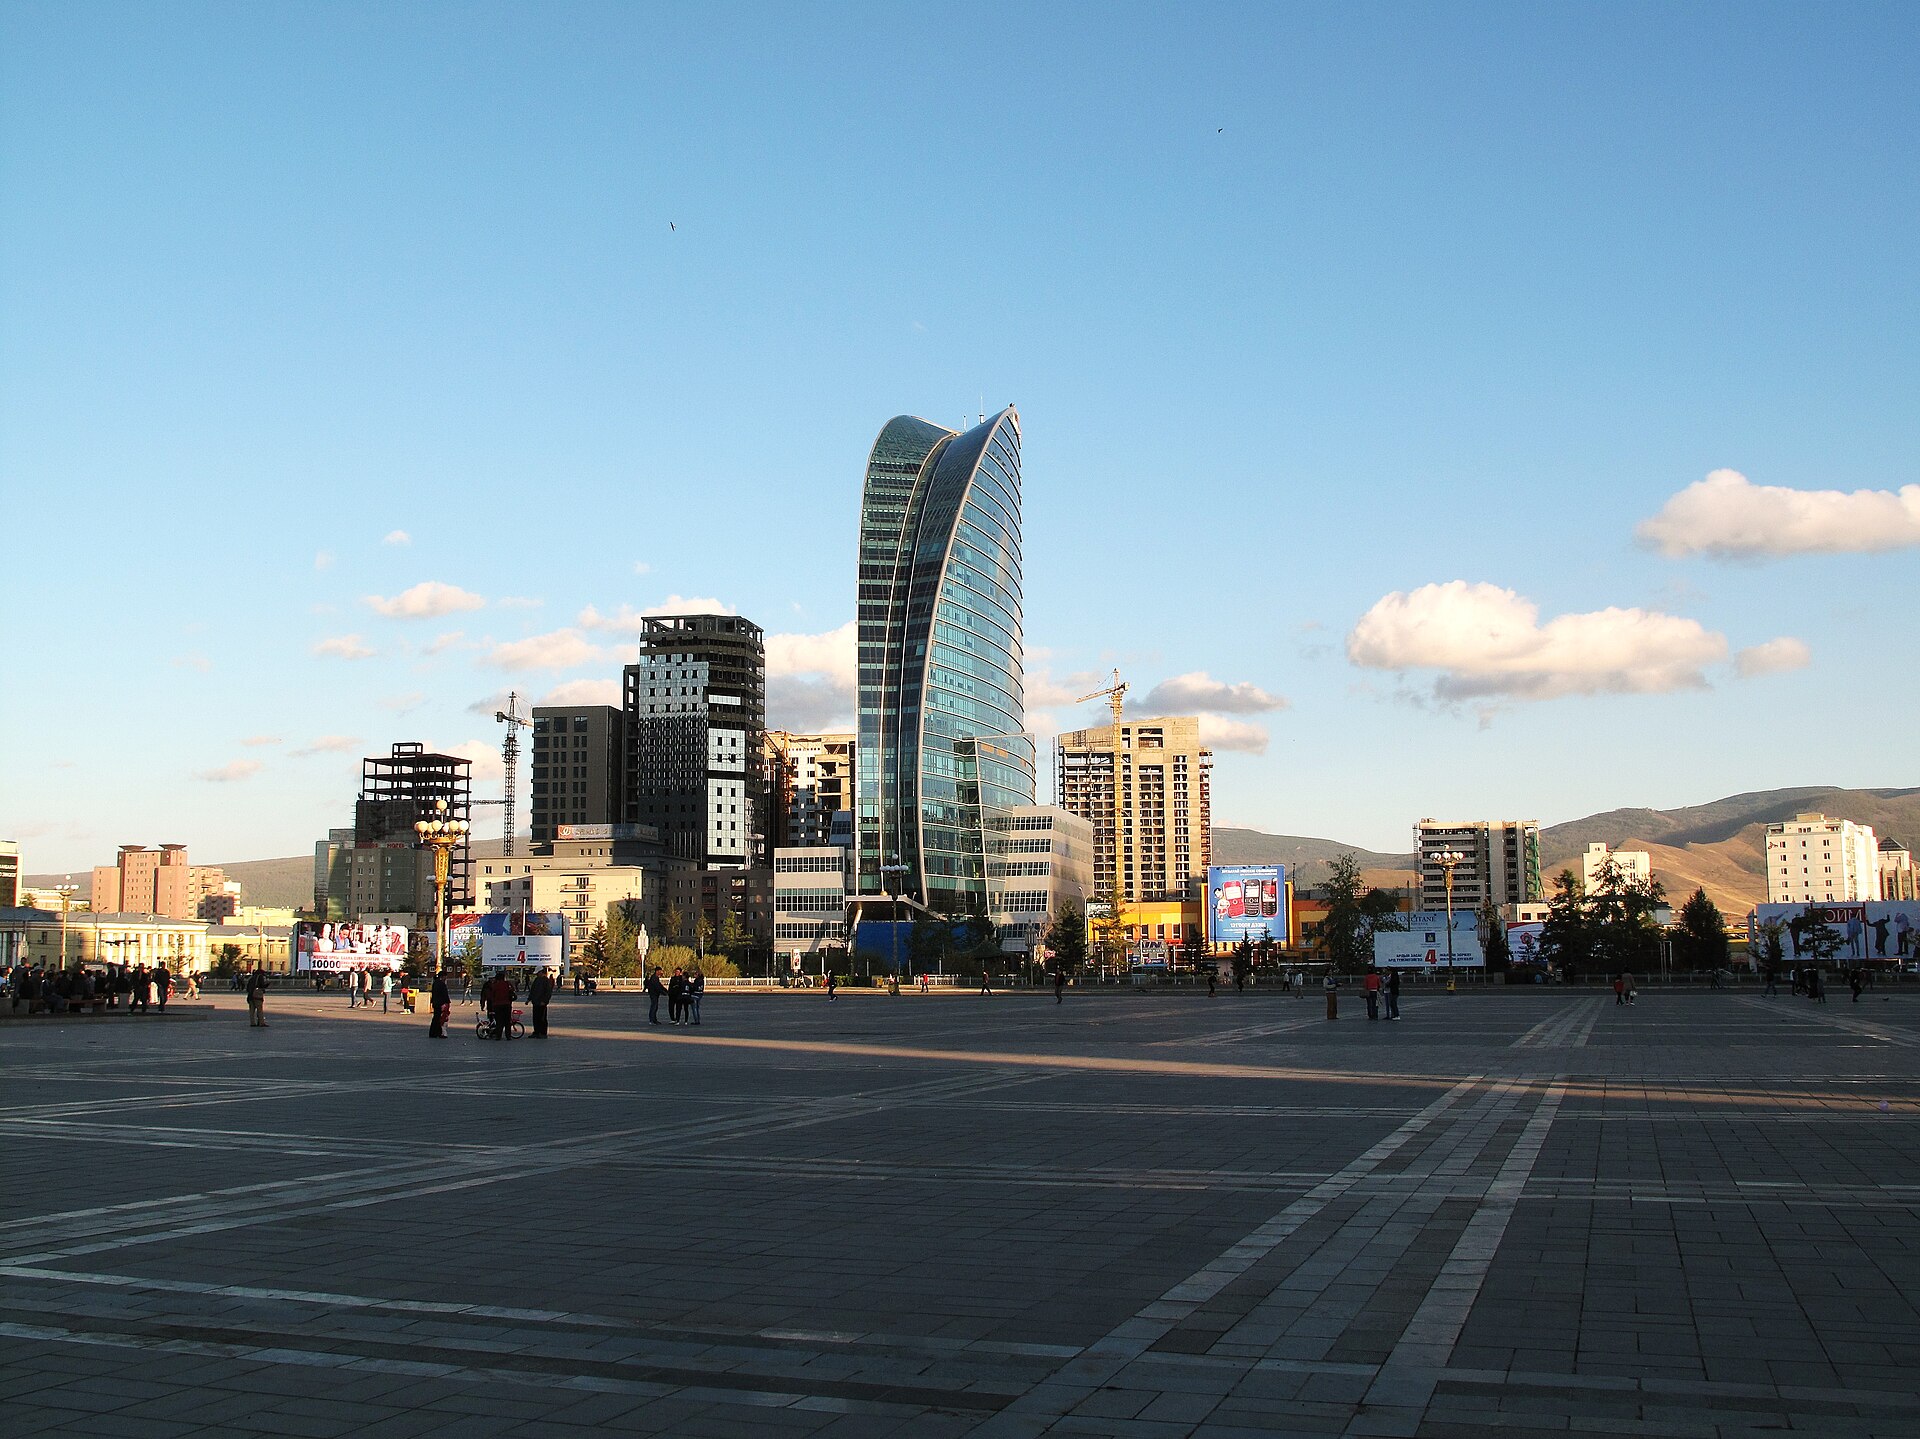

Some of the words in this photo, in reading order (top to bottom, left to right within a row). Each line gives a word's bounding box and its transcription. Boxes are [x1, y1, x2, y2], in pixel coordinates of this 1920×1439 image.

[517, 950, 526, 963] 4
[1425, 949, 1437, 964] 4
[312, 960, 341, 968] 10000
